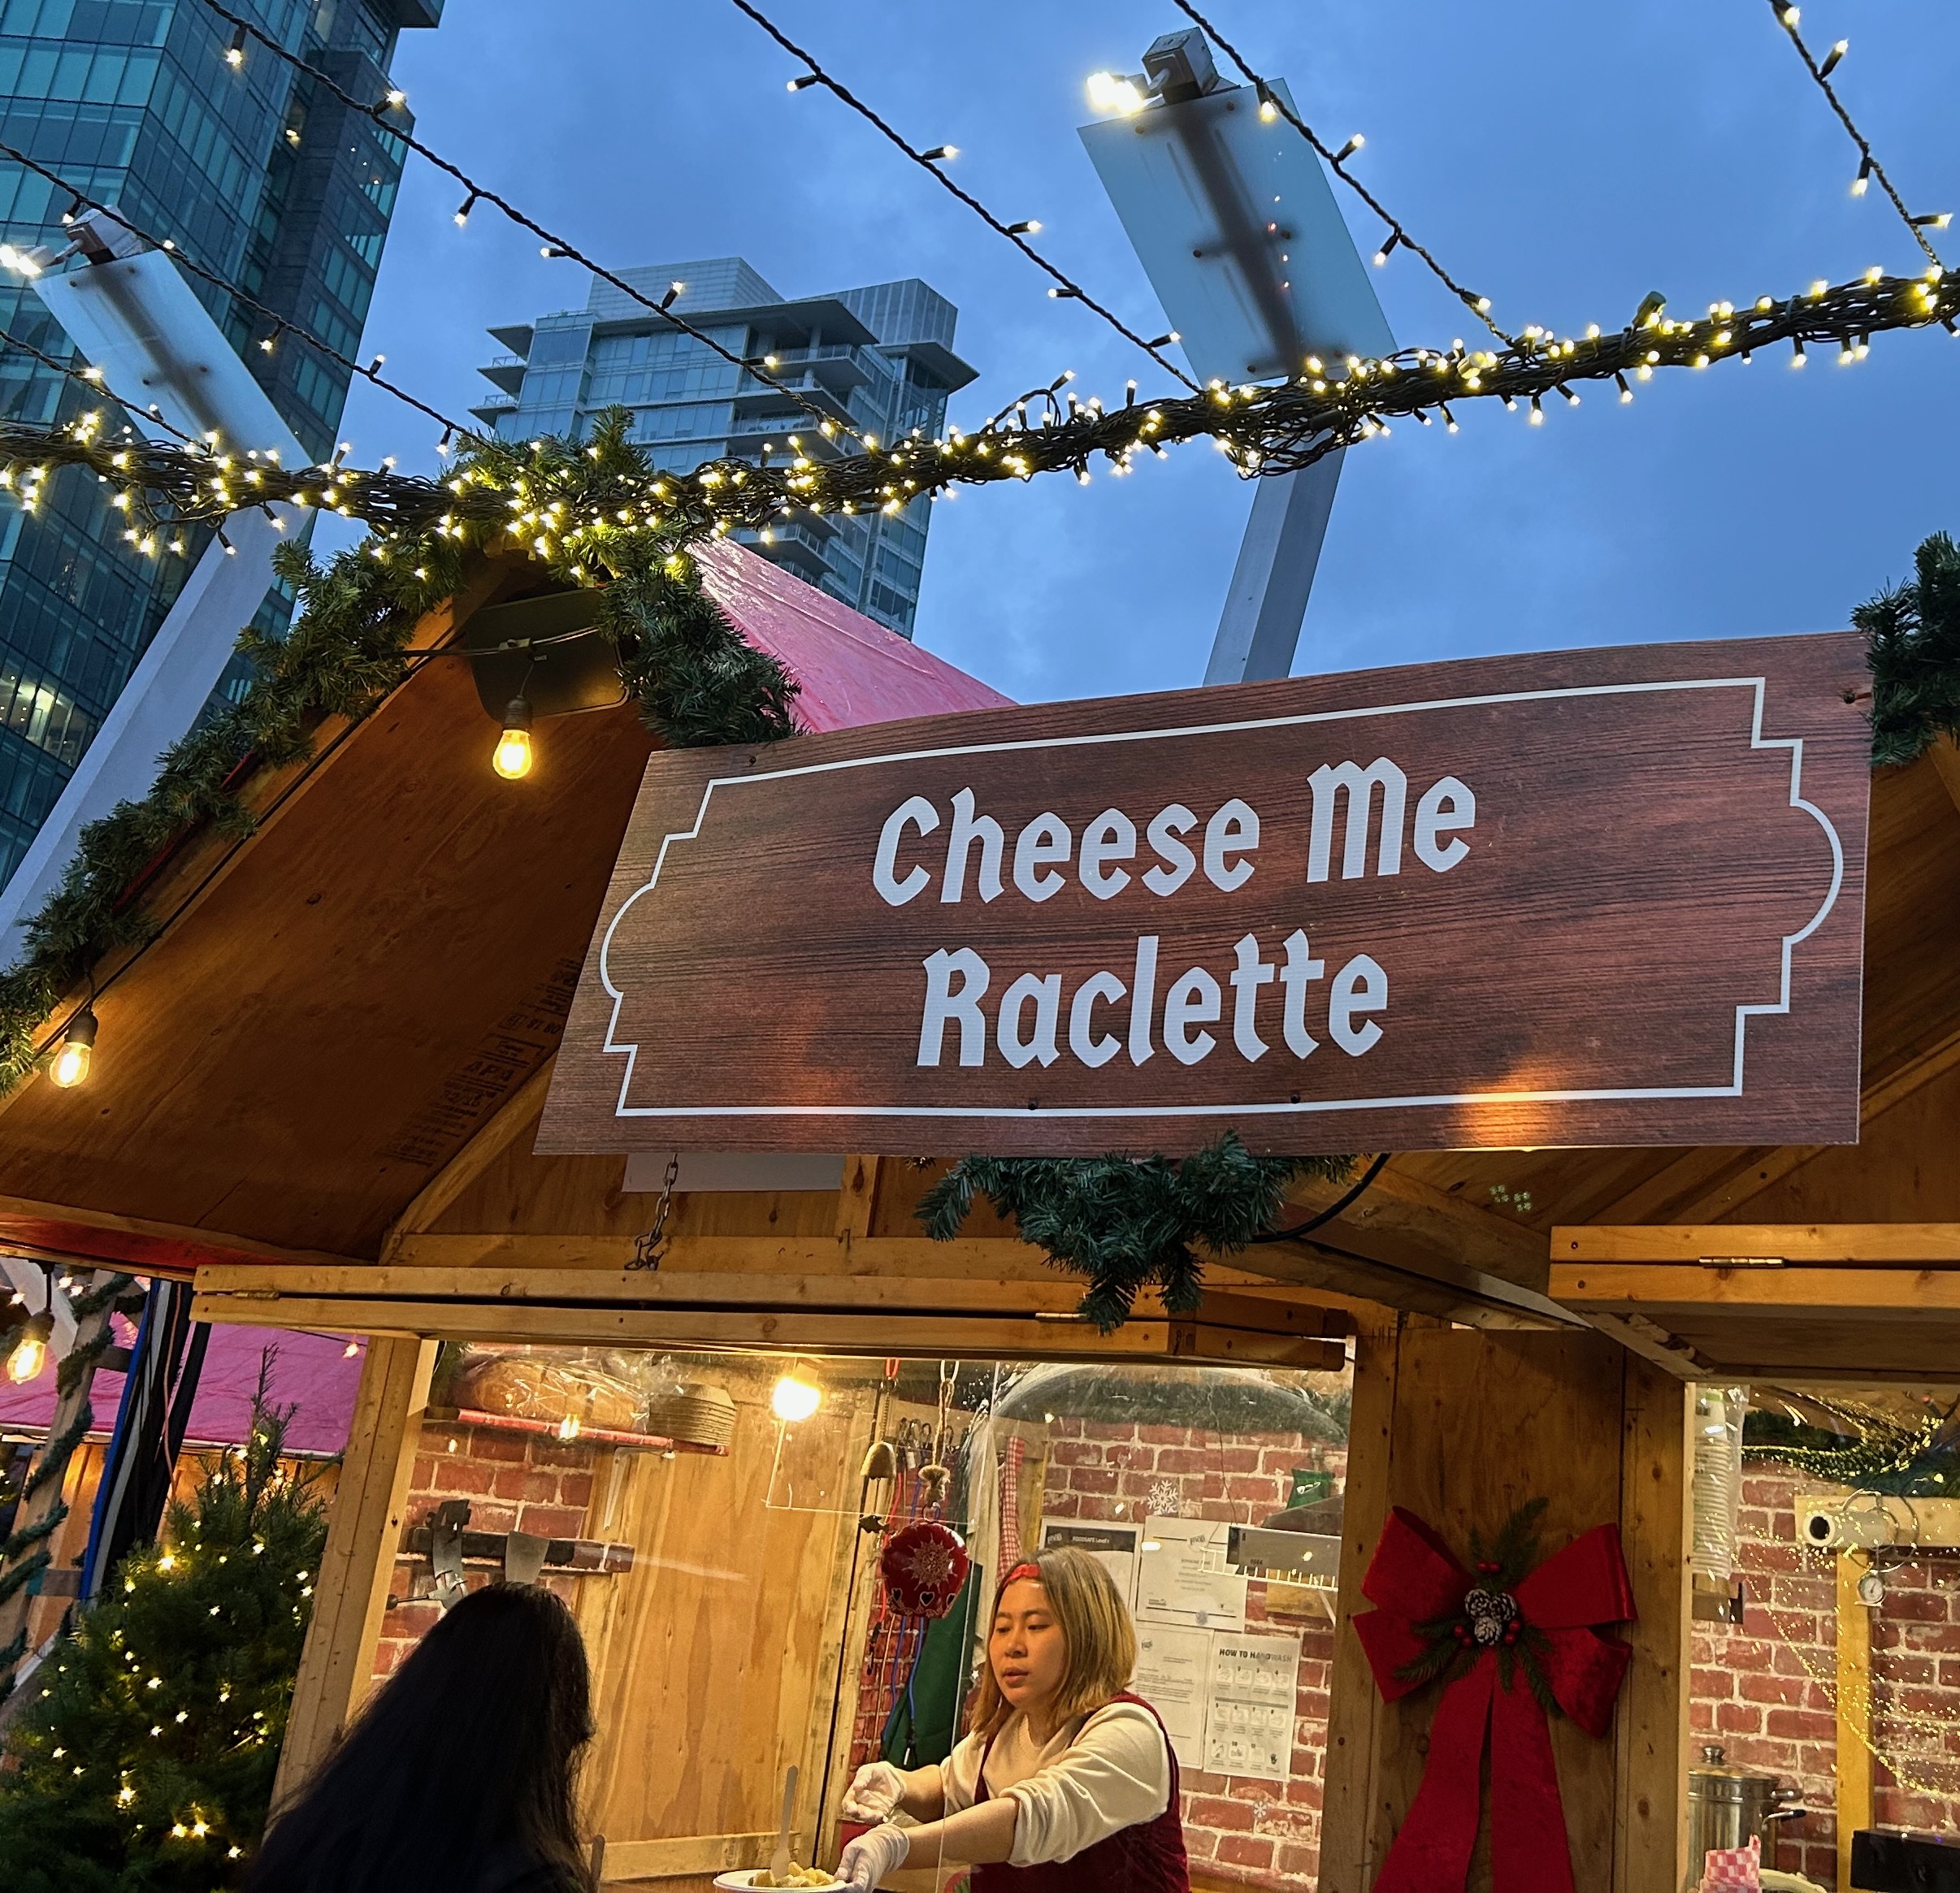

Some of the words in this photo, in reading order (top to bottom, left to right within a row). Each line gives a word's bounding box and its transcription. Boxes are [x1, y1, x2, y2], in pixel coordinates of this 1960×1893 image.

[873, 787, 1260, 906] Cheese
[1306, 756, 1476, 883] Me
[917, 928, 1388, 1068] Raclette
[1219, 1648, 1238, 1657] HOW
[1239, 1650, 1248, 1658] TO
